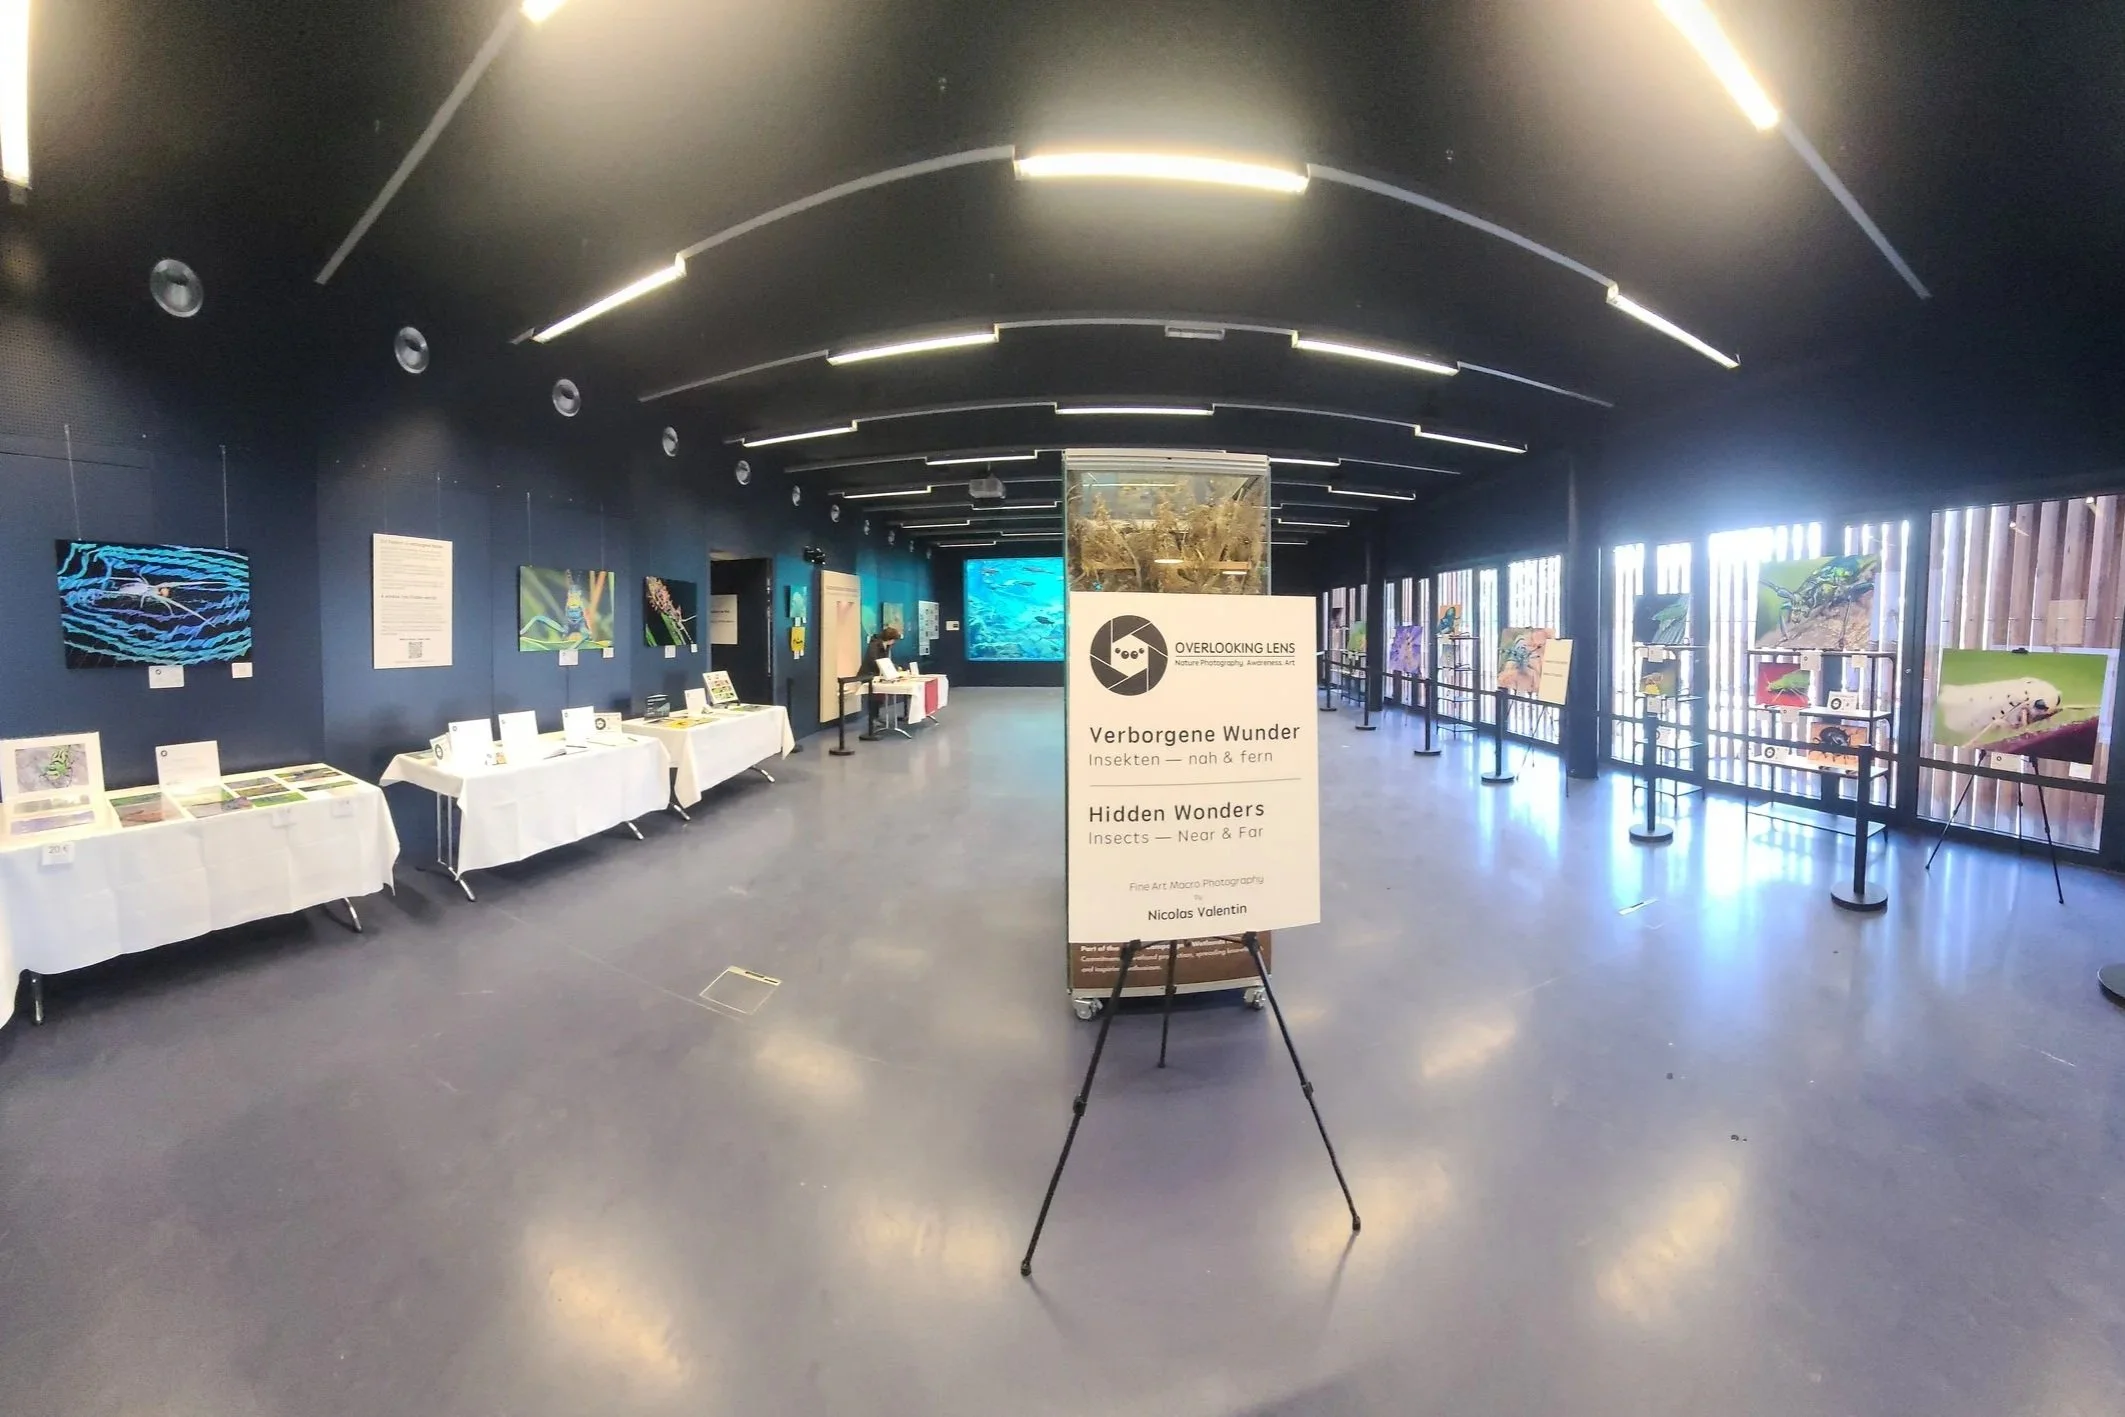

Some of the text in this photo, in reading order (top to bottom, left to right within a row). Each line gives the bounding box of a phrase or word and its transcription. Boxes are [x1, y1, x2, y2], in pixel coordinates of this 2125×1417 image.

[1175, 642, 1296, 654] OVERLOOKING LENS
[1089, 724, 1300, 747] Verborgene Wunder
[1088, 753, 1160, 766] Insekten
[1188, 752, 1218, 765] nah
[1223, 752, 1233, 764] &
[1241, 751, 1273, 763] fern
[1089, 802, 1265, 823] Hidden Wonders
[1088, 831, 1150, 845] Insects
[1178, 829, 1215, 843] Near
[1222, 829, 1232, 840] &
[1239, 826, 1264, 838] Far
[1129, 876, 1264, 891] Fine Art Macro Photography
[1148, 904, 1247, 921] Nicolas Valentin
